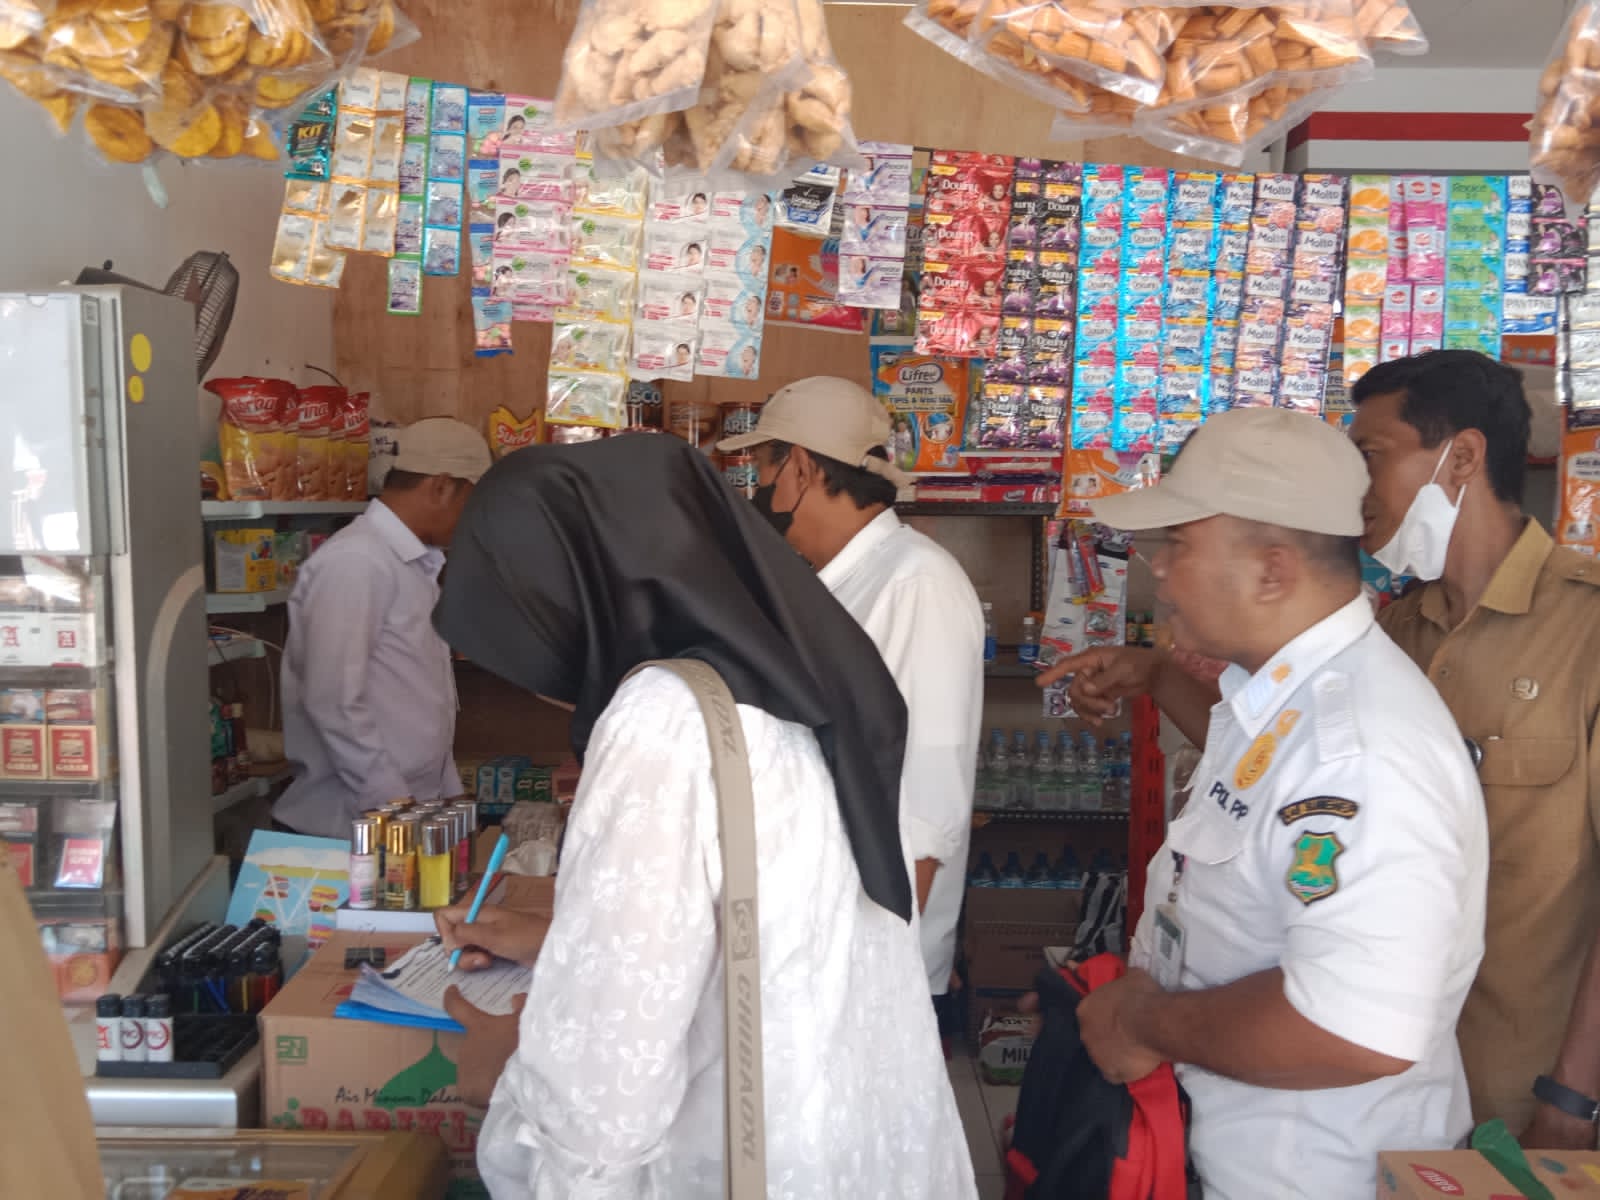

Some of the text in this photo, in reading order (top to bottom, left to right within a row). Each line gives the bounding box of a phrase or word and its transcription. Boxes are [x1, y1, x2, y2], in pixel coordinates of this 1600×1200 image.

[297, 123, 324, 139] KIT
[942, 180, 978, 194] Downy
[1263, 184, 1292, 196] Molto
[1182, 189, 1207, 199] Molto
[1310, 188, 1340, 200] Molto
[1047, 202, 1080, 216] Downy
[938, 228, 973, 242] Downy
[1257, 232, 1286, 244] Molto
[1304, 235, 1334, 248] Molto
[1041, 270, 1073, 284] Downy
[934, 277, 969, 290] Downy
[1251, 280, 1281, 292] Molto
[1175, 286, 1200, 296] Molto
[1298, 285, 1327, 297] Molto
[1247, 328, 1275, 340] Molto
[1293, 333, 1322, 345] Molto
[1241, 376, 1270, 387] Molto
[1287, 380, 1316, 392] Molto
[1228, 801, 1249, 821] PP
[364, 1087, 417, 1104] Minum
